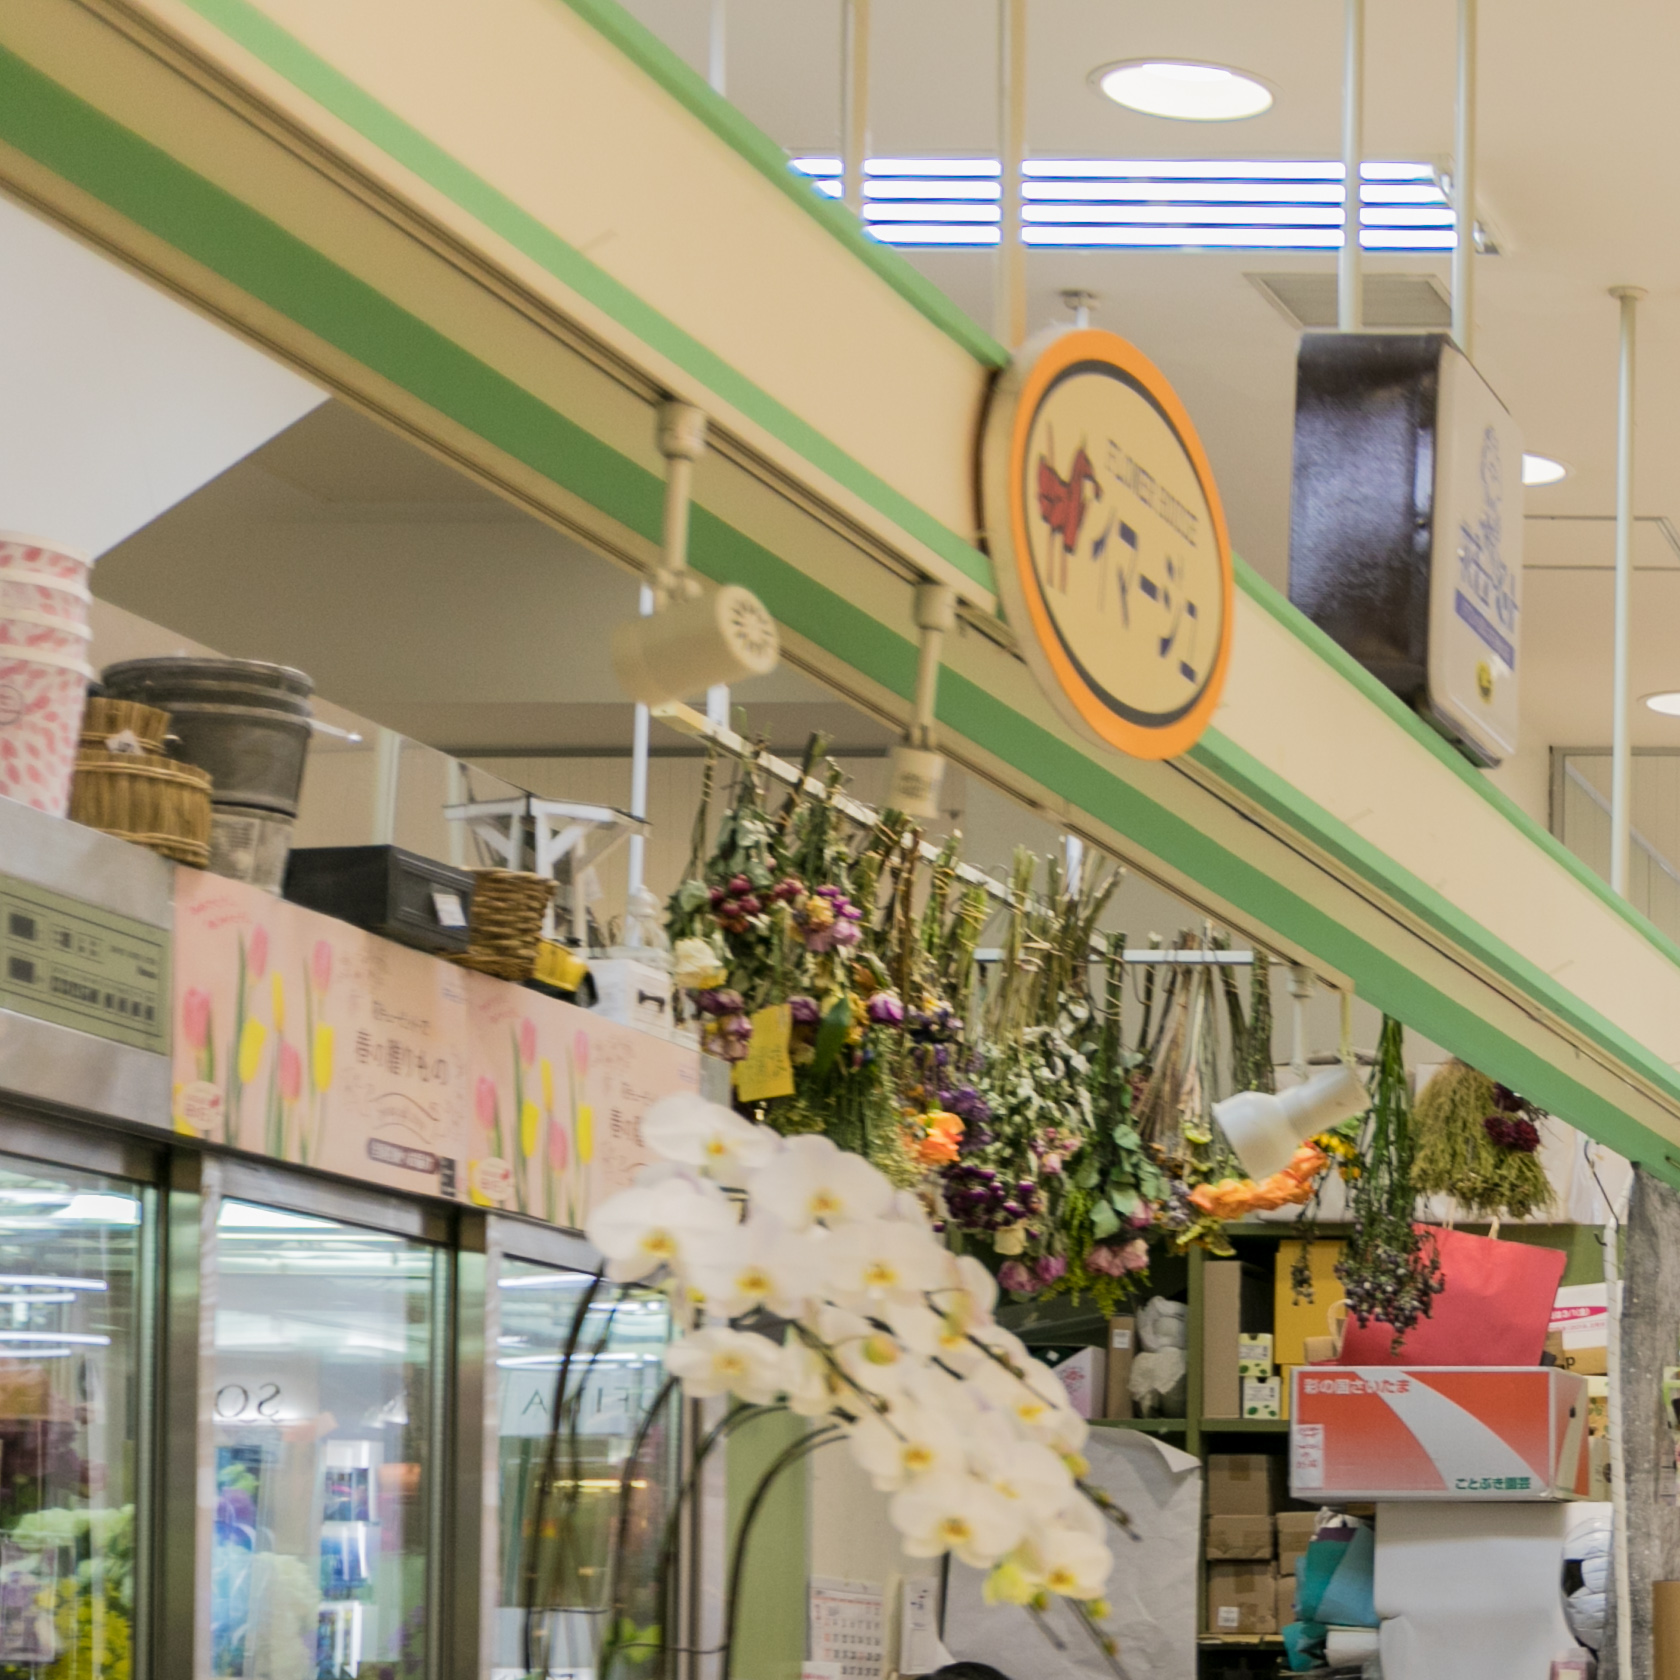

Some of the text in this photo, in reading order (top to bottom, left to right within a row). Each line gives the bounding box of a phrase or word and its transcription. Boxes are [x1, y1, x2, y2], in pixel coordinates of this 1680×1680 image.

[1303, 1378, 1411, 1395] 彩の国さいたま
[1454, 1476, 1531, 1491] ことぶき園芸
